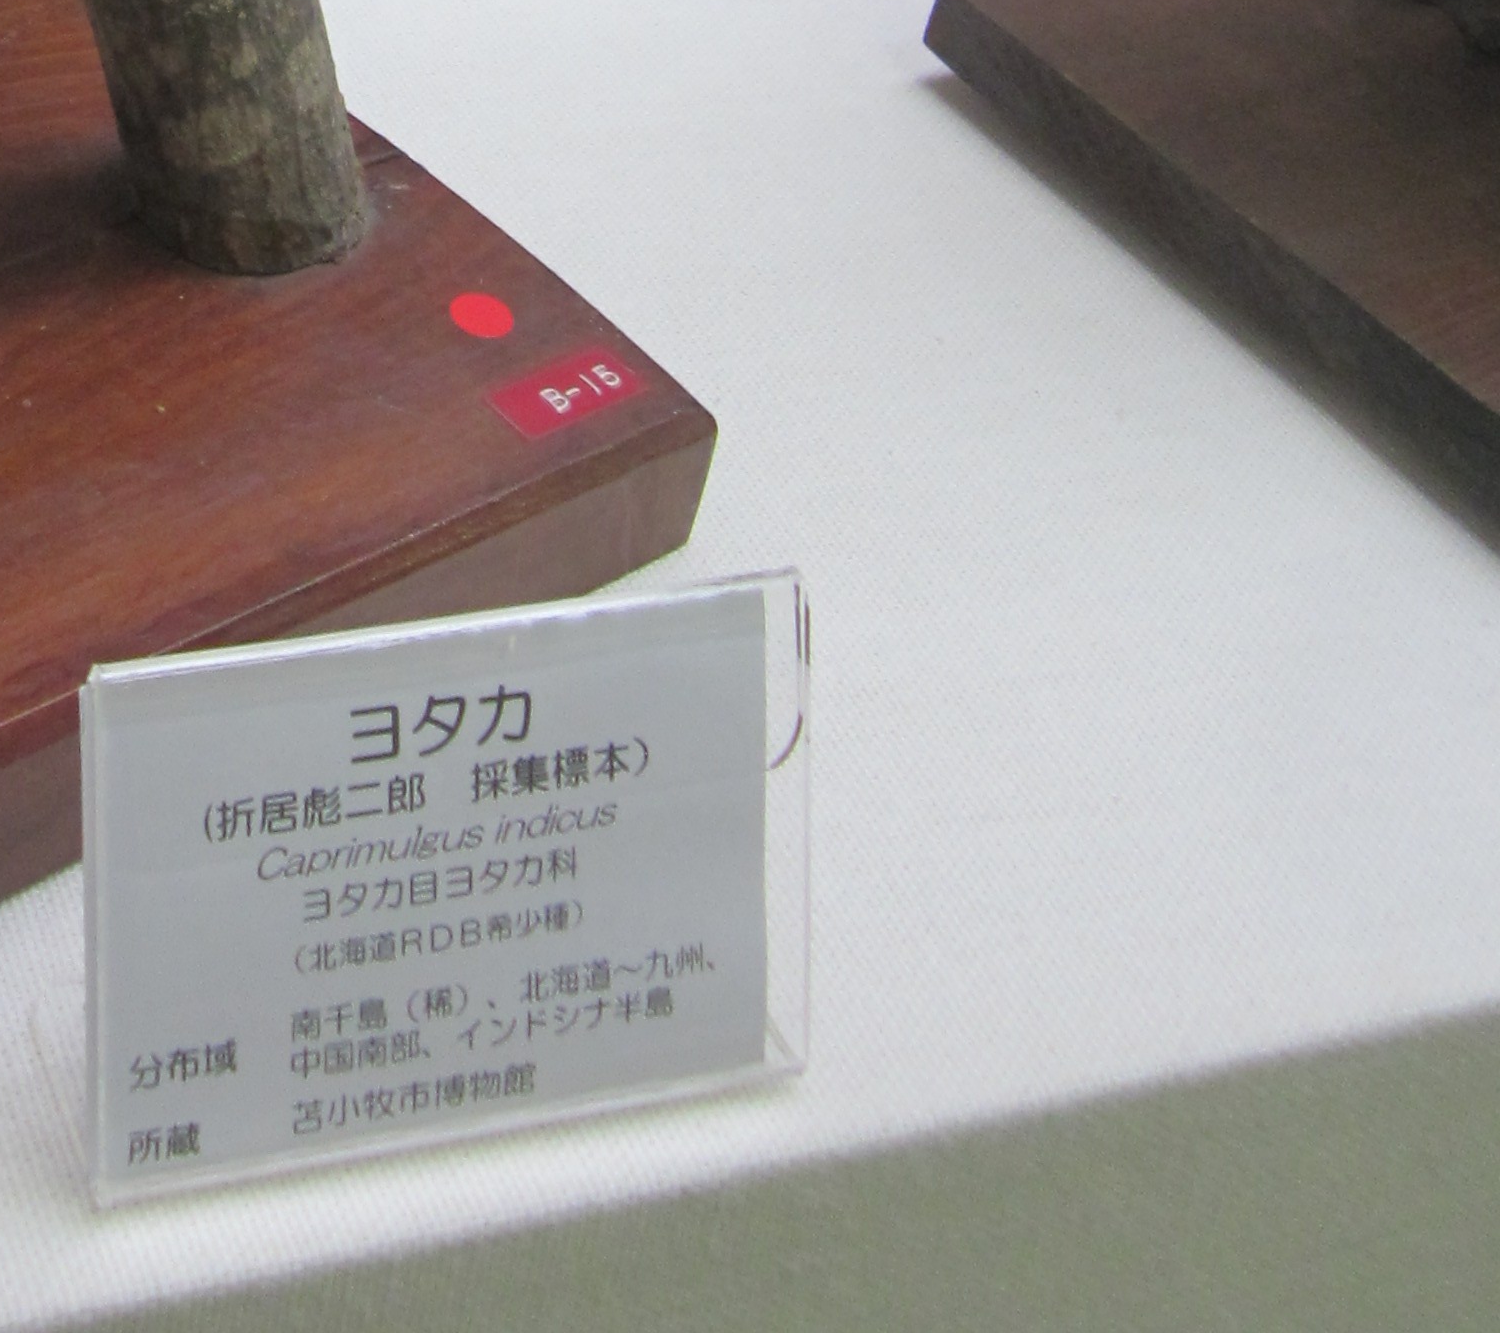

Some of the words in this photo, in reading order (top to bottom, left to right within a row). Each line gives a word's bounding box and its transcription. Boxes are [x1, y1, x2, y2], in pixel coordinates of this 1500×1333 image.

[539, 364, 621, 414] B-15
[349, 684, 533, 765] ヨタカ
[470, 737, 650, 804] 採集標本)
[256, 822, 485, 883] Caprimulgus
[493, 801, 618, 845] indicus
[302, 846, 579, 924] ヨタカ目ヨタカ科
[129, 1036, 239, 1092] 分布域
[290, 985, 676, 1080] 中国南部、インドシナ半島
[127, 1120, 202, 1166] 所蔵
[292, 1062, 537, 1136] 苫小牧市博物館
